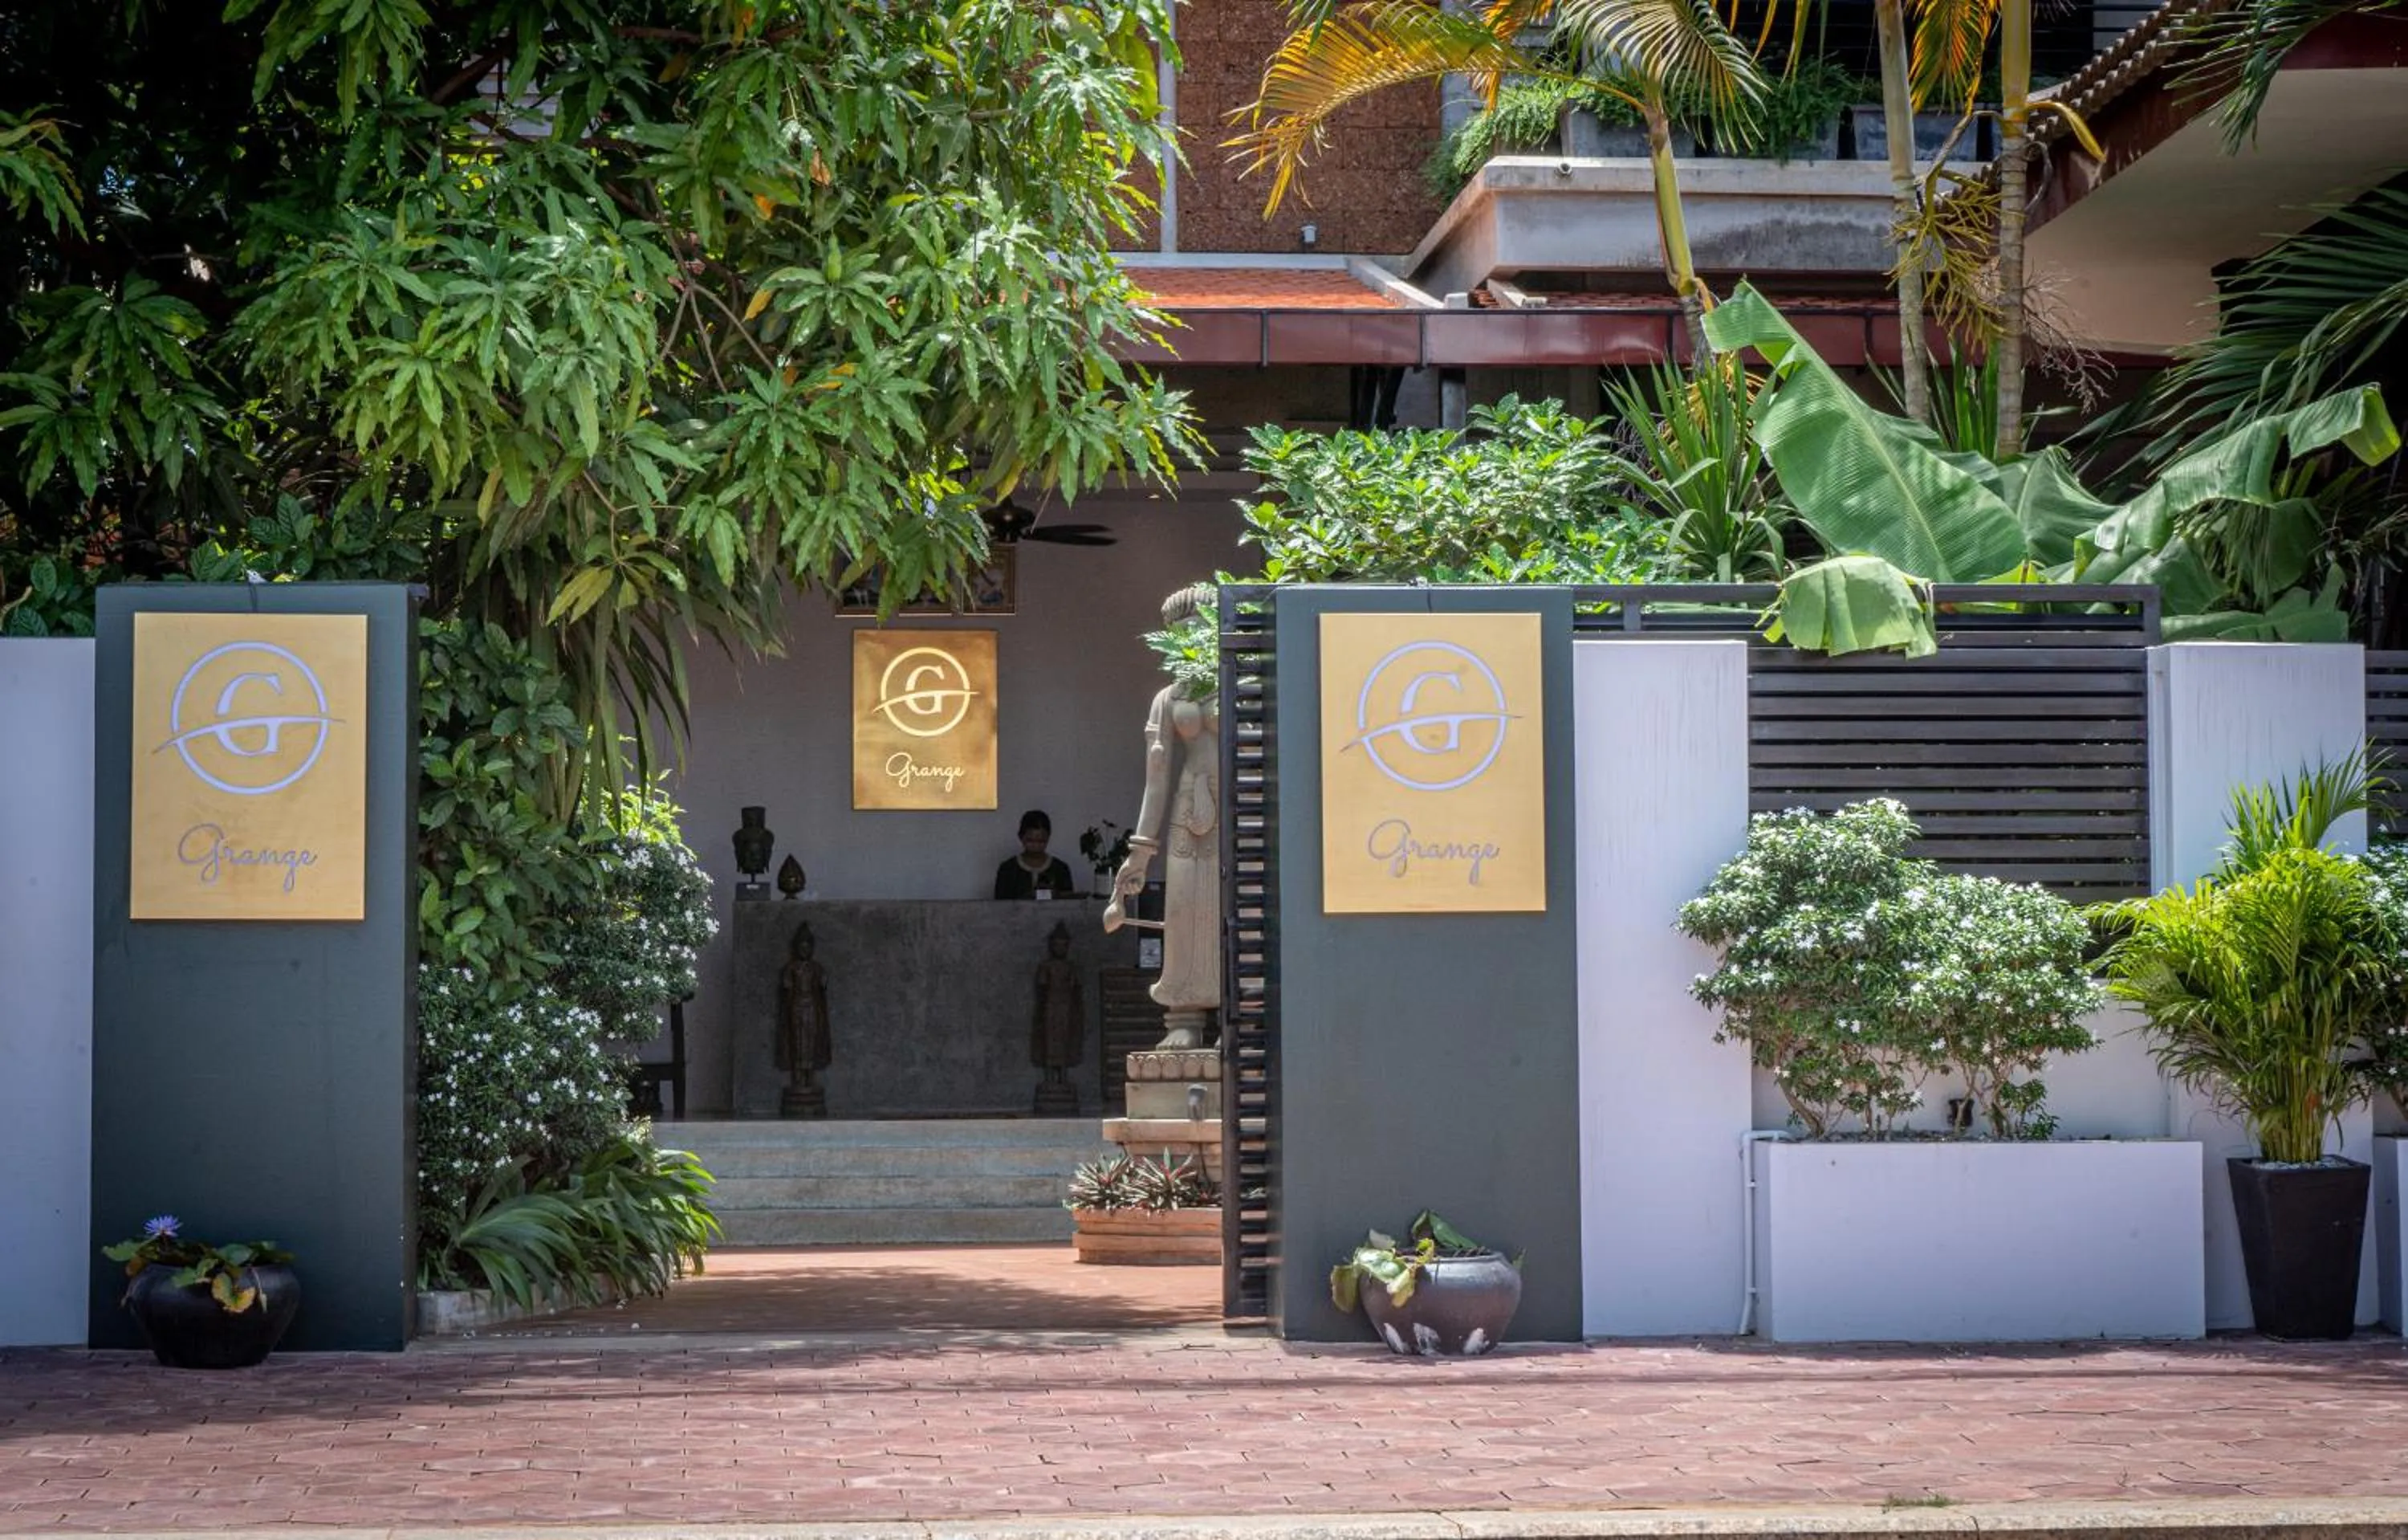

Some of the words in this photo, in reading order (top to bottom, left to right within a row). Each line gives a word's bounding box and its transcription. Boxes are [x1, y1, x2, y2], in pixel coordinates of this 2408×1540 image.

[214, 671, 282, 756] G
[905, 665, 945, 715] G
[1400, 670, 1463, 754] G
[885, 752, 964, 792] Grange
[178, 822, 318, 893] Grange
[1367, 818, 1501, 886] Grange
